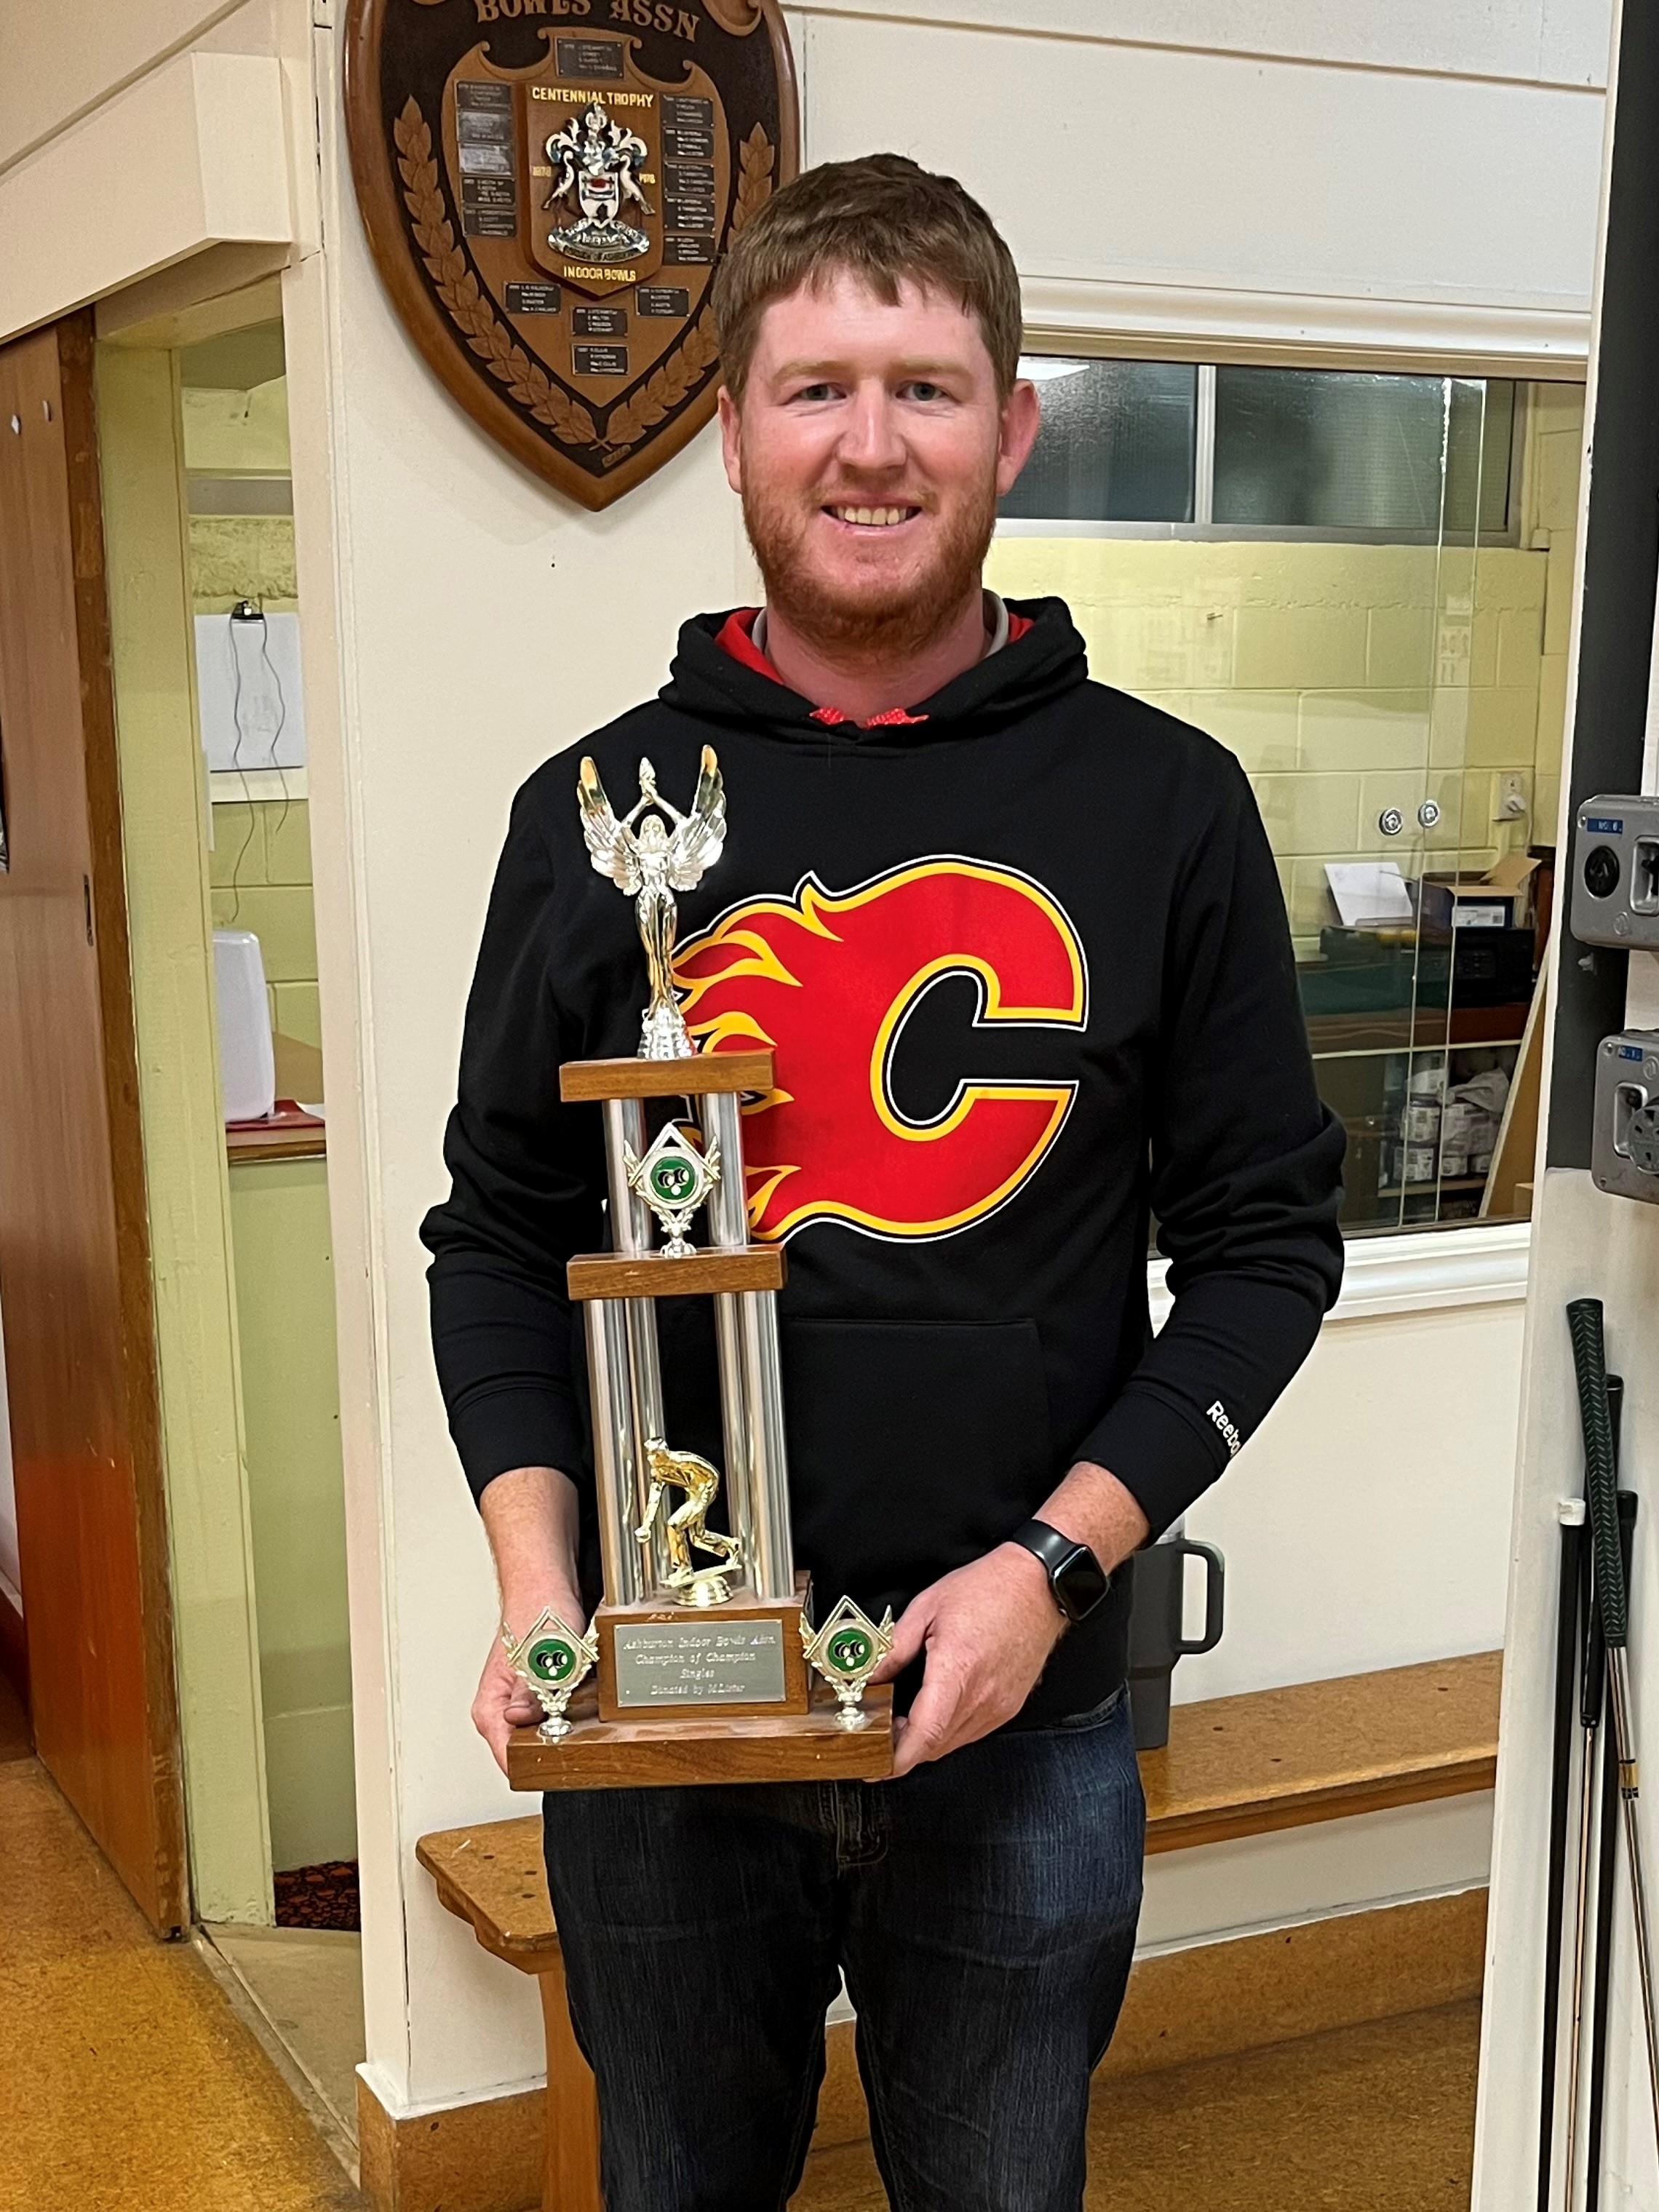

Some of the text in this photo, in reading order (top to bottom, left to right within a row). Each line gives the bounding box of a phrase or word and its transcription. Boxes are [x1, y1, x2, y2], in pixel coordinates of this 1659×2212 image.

[608, 0, 700, 42] ASSN
[532, 87, 654, 108] CENTENNIAL TROPHY
[563, 265, 636, 282] INDOOR BOWLS
[690, 1652, 702, 1665] of
